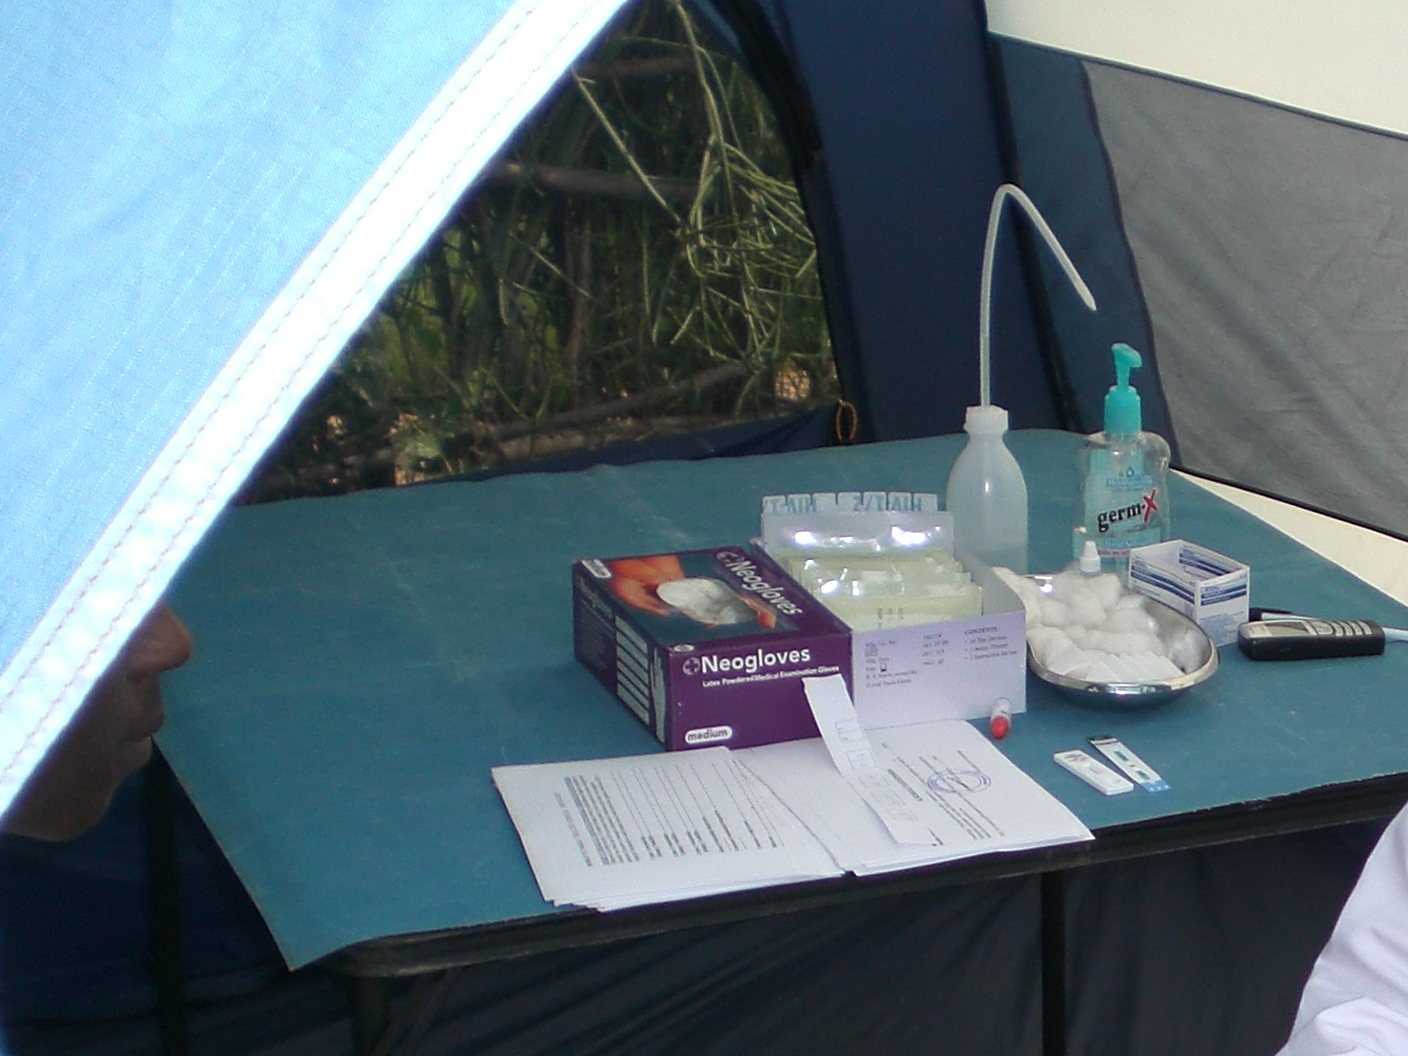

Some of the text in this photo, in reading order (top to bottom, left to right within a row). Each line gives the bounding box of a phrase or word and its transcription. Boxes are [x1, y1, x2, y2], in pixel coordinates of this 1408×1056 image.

[1097, 489, 1158, 533] germ-X
[725, 560, 803, 615] Neogloves
[701, 648, 811, 673] Neogloves
[702, 665, 840, 688] Latex Powdered Medical Examination Gloves
[687, 728, 728, 742] medium
